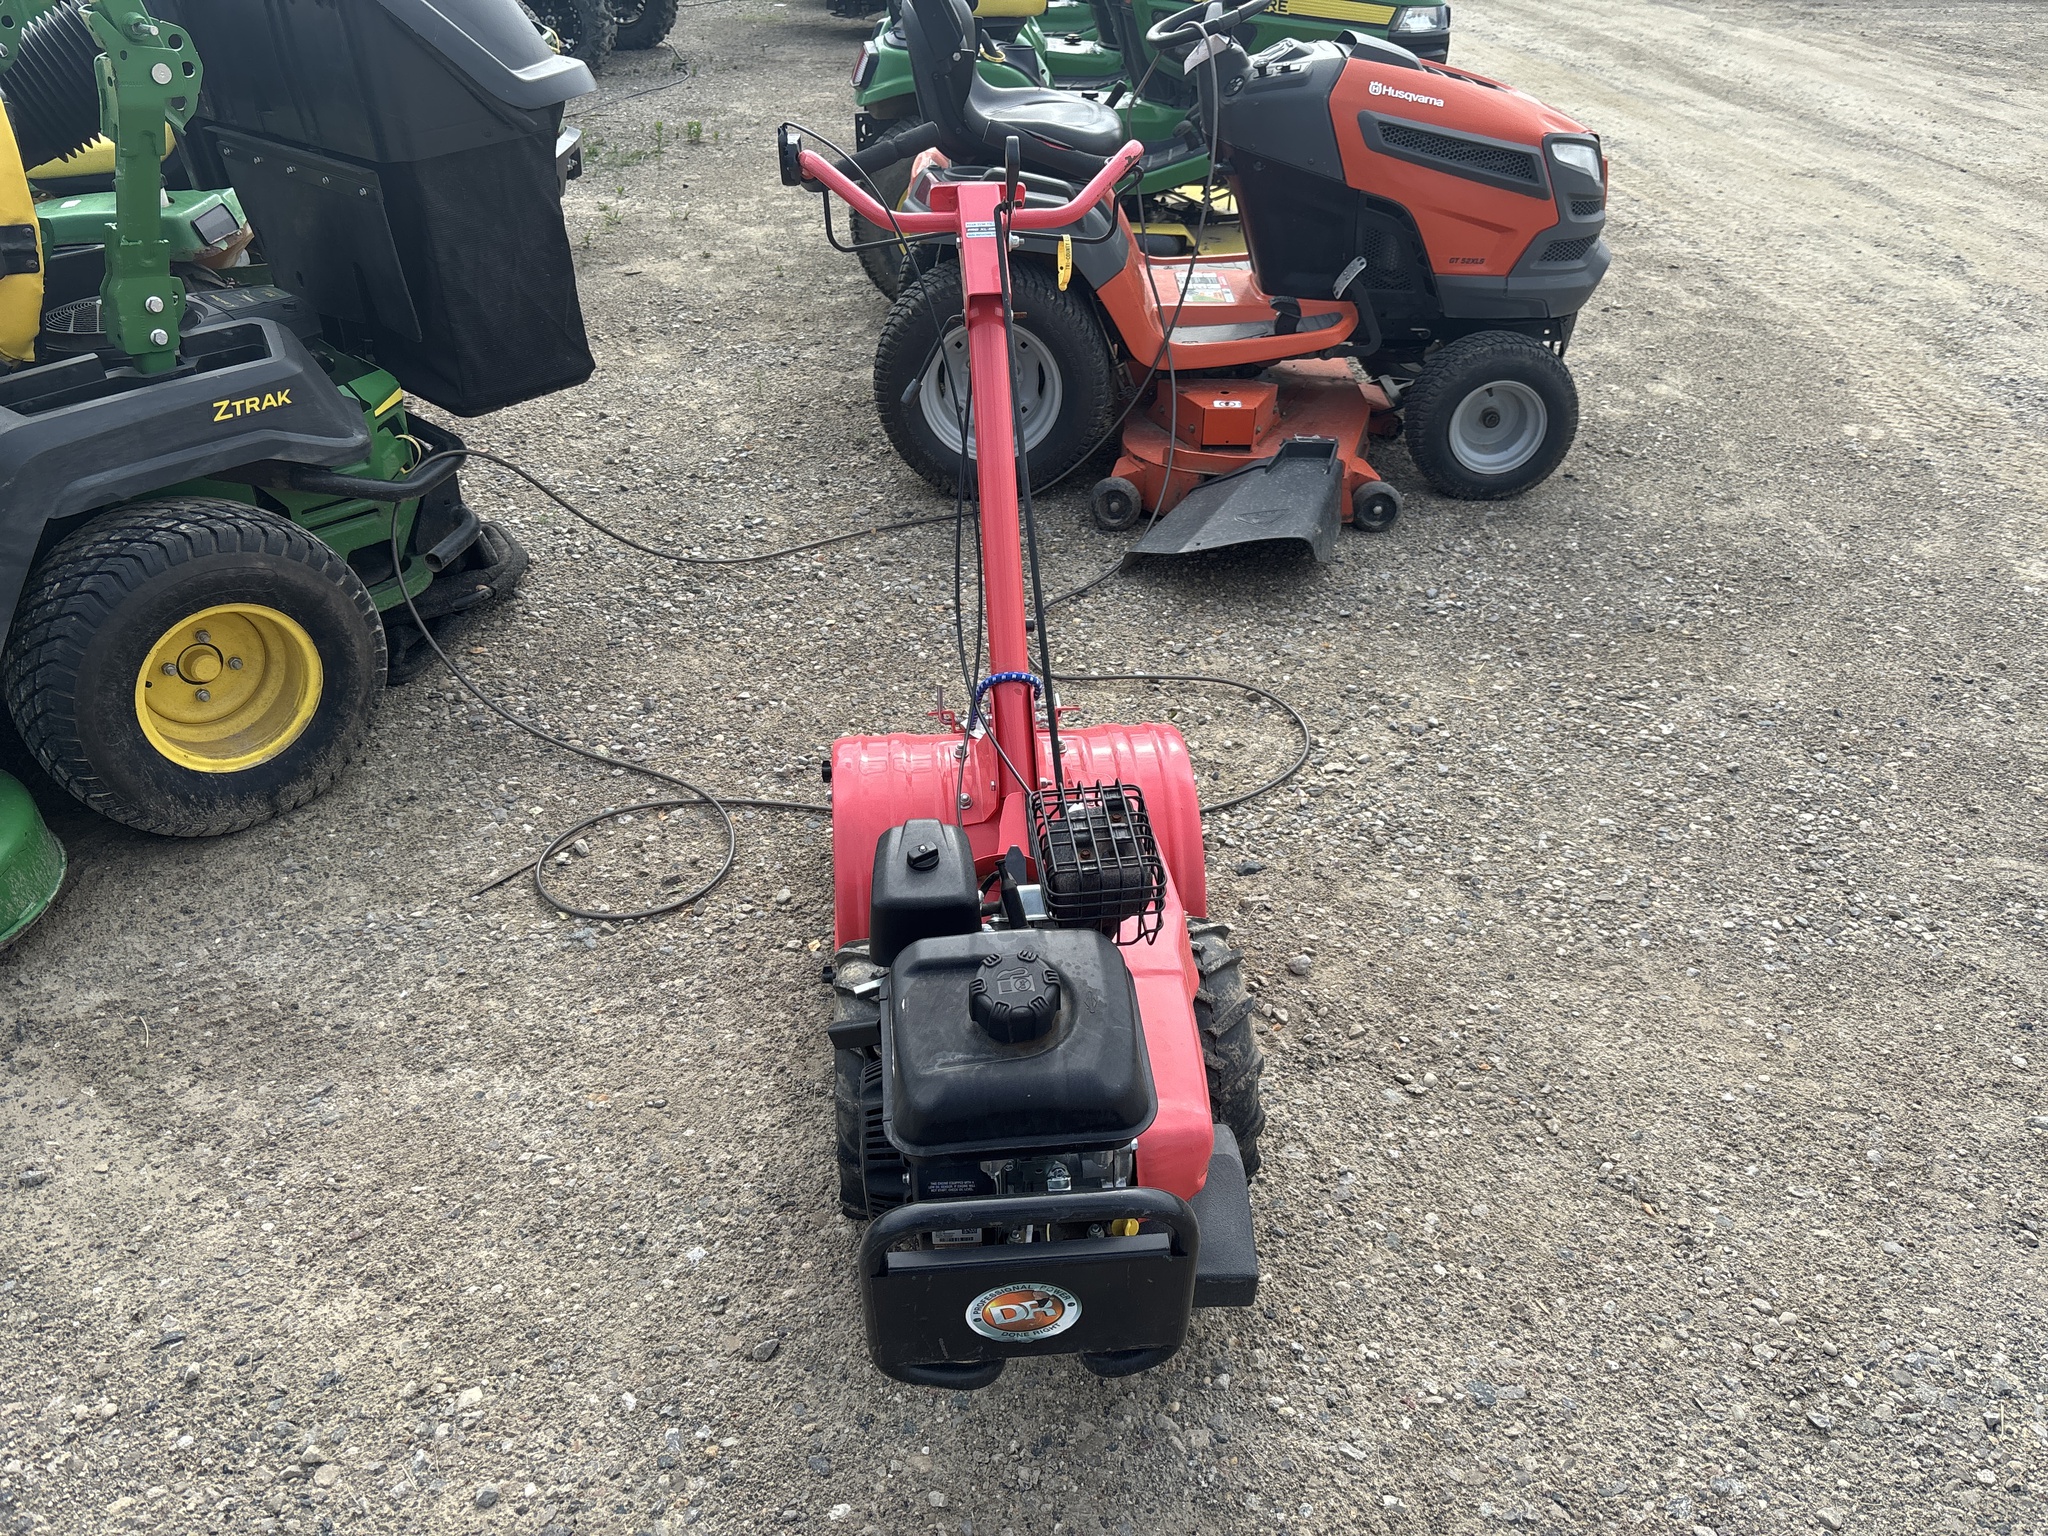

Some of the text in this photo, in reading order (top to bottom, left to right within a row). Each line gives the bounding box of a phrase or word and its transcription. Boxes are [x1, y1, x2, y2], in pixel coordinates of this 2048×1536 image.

[1382, 85, 1444, 107] Husqvarna
[213, 388, 292, 422] ZTRAK
[973, 1284, 1071, 1315] PROFESSIONAL POWER
[989, 1300, 1057, 1325] DR
[1033, 1323, 1061, 1336] RIGHT
